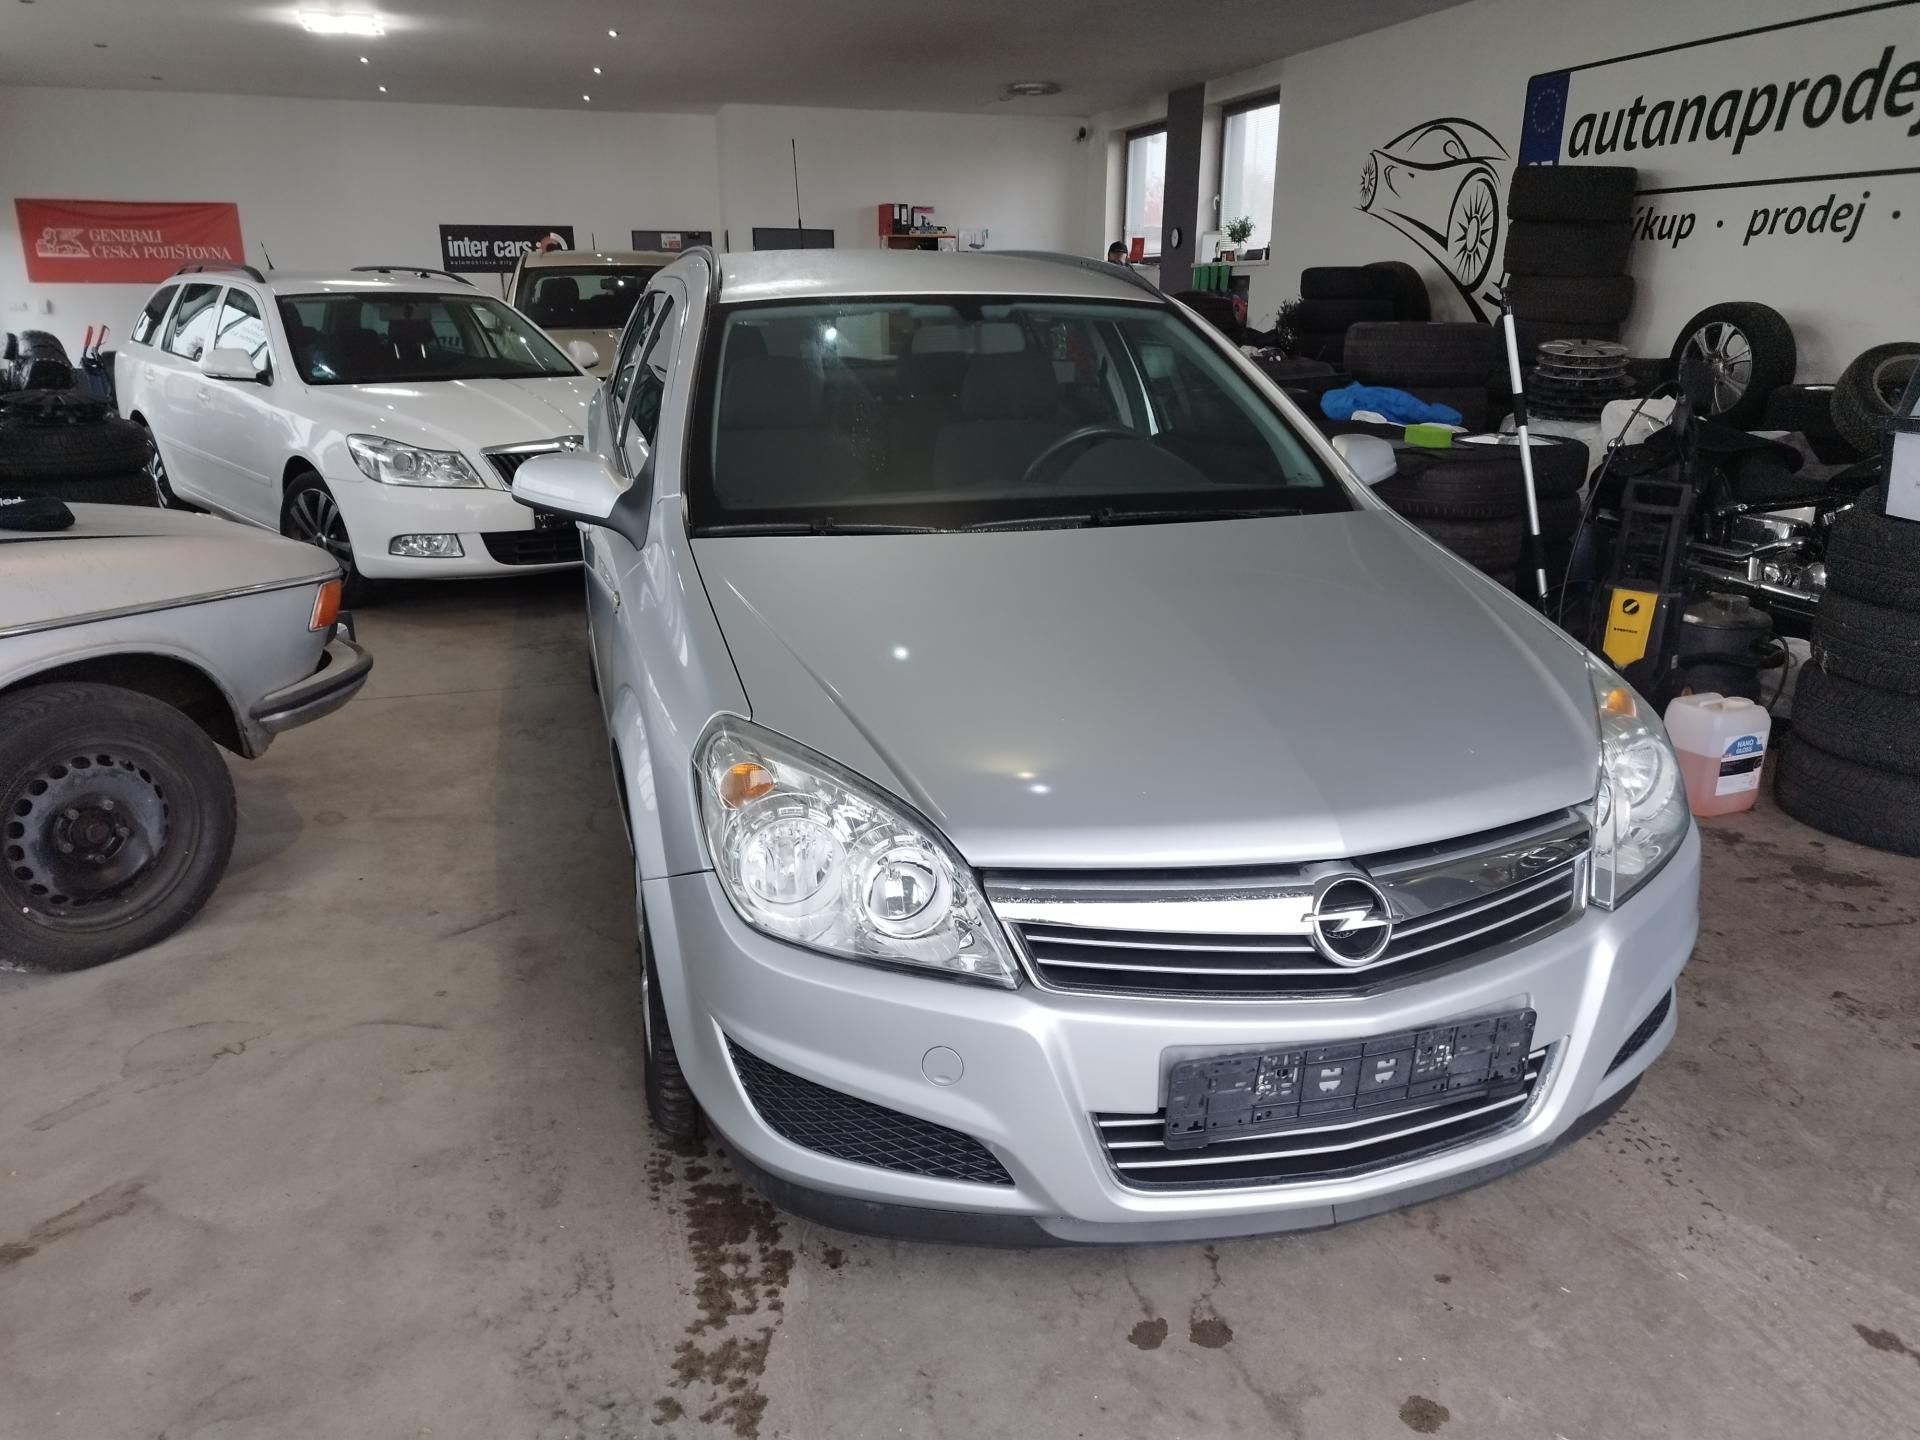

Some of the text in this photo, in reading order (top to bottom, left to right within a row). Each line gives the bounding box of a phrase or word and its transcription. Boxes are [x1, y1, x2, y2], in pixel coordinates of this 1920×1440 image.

[1631, 191, 1871, 249] ýkup prodej
[89, 228, 162, 243] GENERALI
[91, 242, 140, 258] ČESKÁ
[448, 236, 532, 258] inter cars
